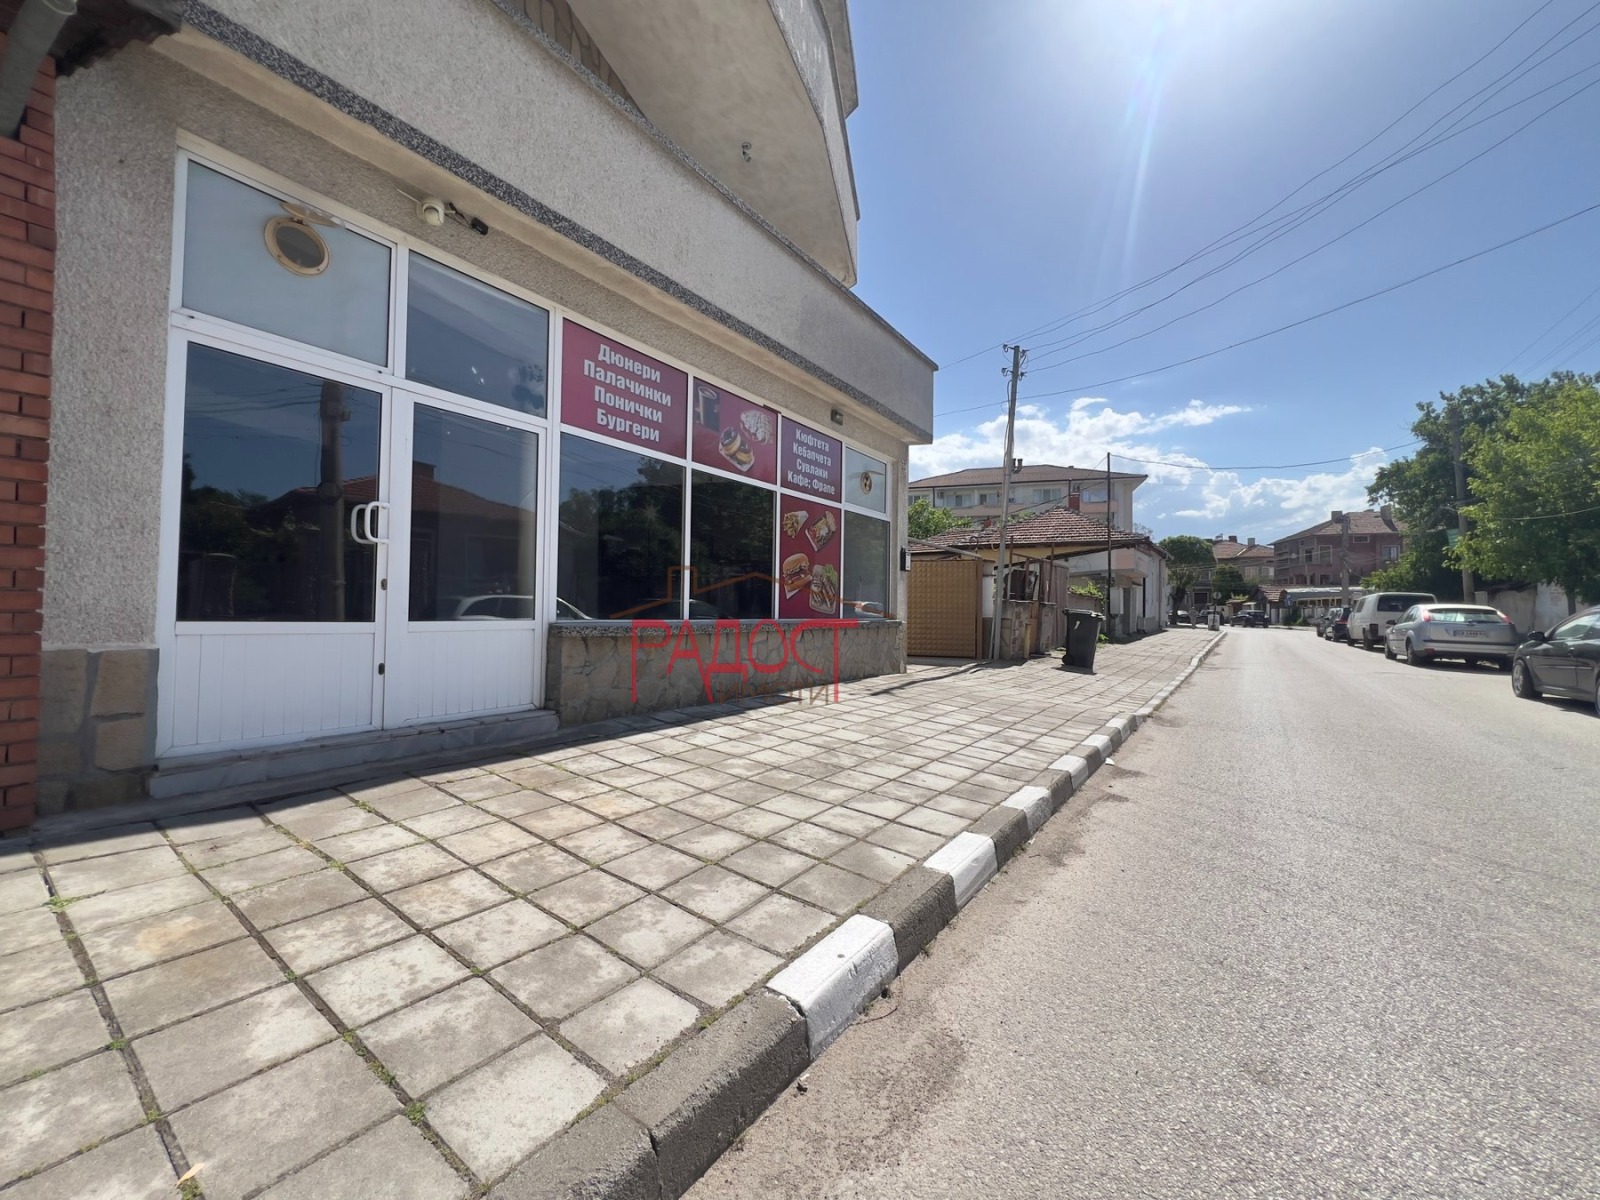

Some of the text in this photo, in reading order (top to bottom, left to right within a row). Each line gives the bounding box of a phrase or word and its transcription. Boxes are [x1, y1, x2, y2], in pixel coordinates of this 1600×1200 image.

[598, 343, 661, 383] Дюнери
[584, 359, 671, 407] Палачинки
[594, 385, 662, 423] Понички
[596, 407, 660, 442] Бургери
[793, 442, 831, 466] Кебапчета
[795, 428, 829, 452] Кюфтета
[796, 458, 828, 479] Сувлаки
[812, 478, 835, 495] Фрапе
